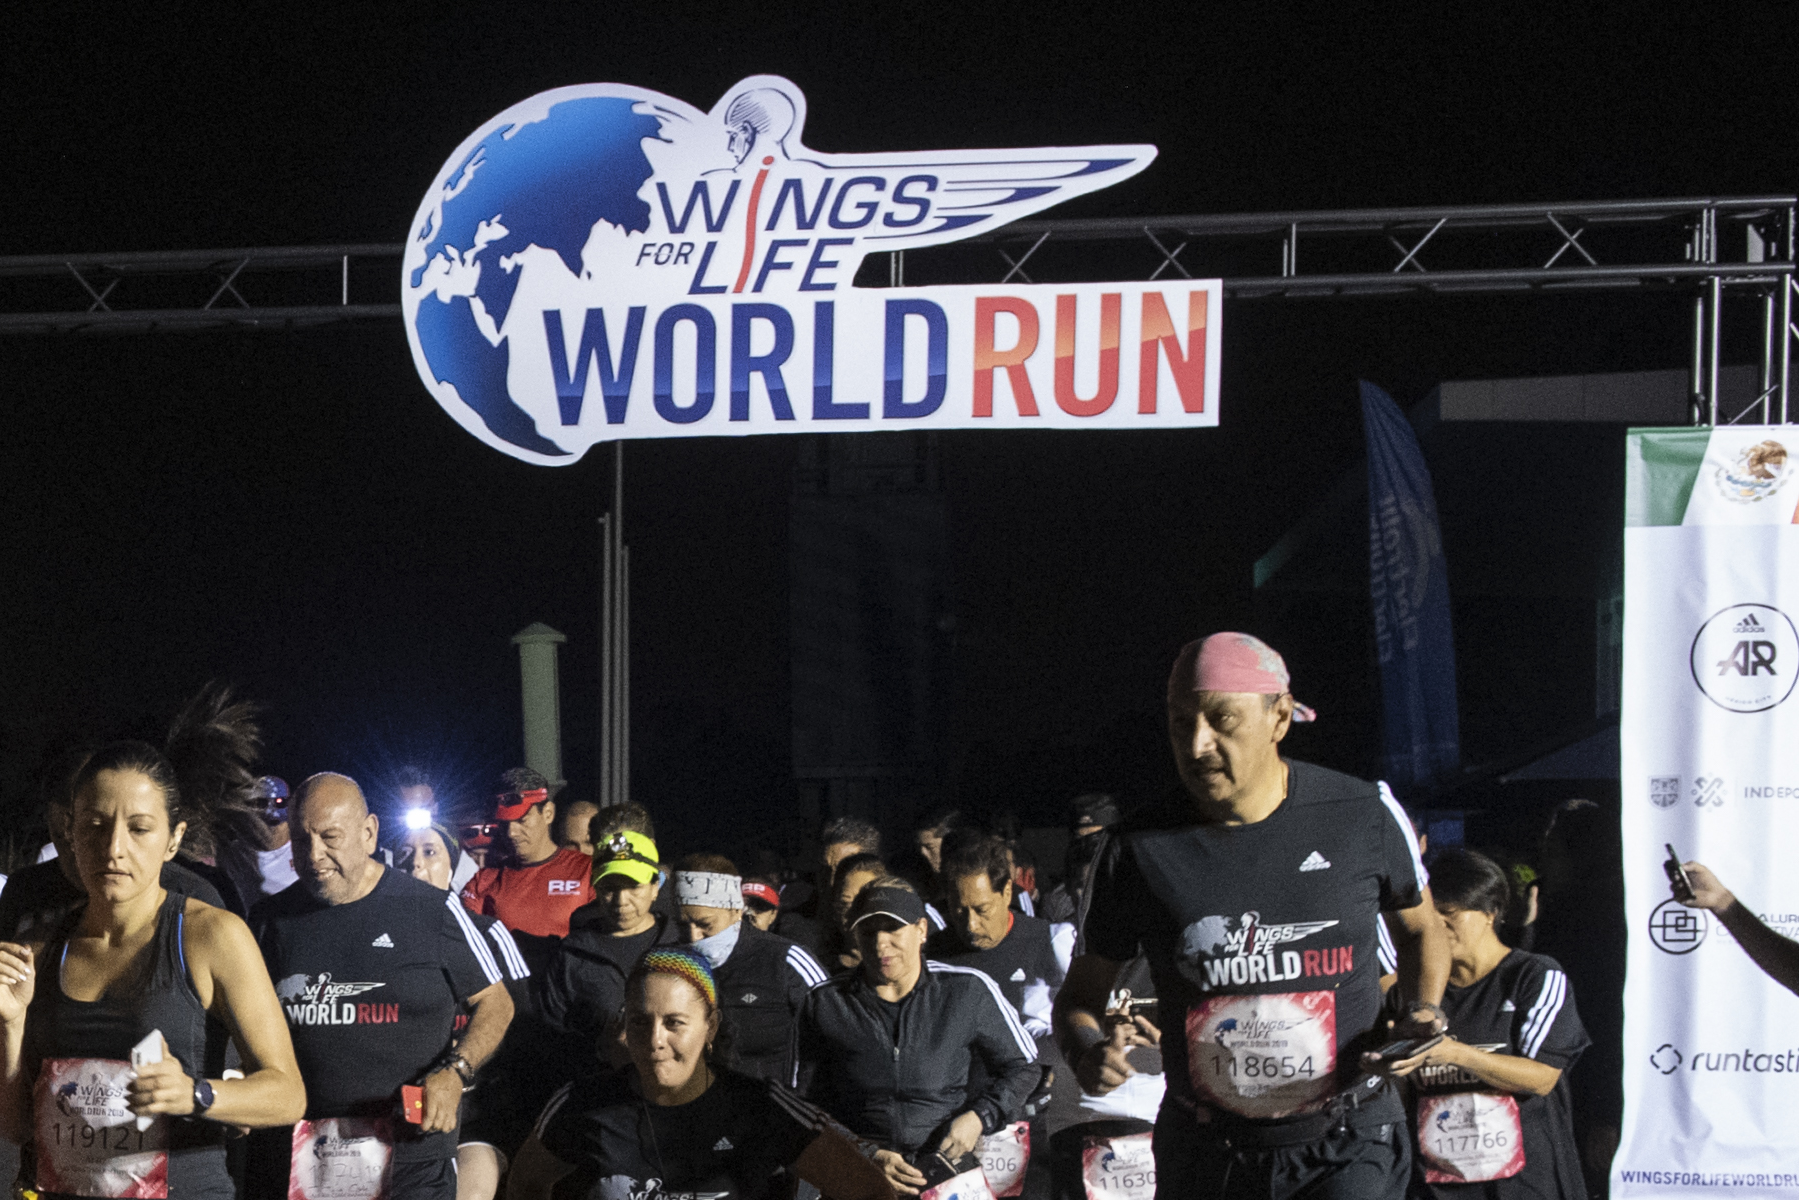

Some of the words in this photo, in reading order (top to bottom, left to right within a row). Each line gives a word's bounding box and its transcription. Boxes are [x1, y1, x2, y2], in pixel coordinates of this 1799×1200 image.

[656, 172, 938, 233] WINGS
[635, 241, 695, 267] FOR
[687, 238, 857, 295] LIFE
[542, 299, 949, 427] WORLD
[971, 289, 1209, 419] RUN
[1733, 626, 1765, 634] adidas
[1716, 640, 1778, 676] AR
[1227, 927, 1295, 945] WINGS
[1203, 950, 1302, 987] WORLD
[1304, 945, 1353, 977] RUN
[286, 1003, 356, 1025] WORLD
[357, 1003, 399, 1025] RUN
[1210, 1054, 1316, 1079] 118654
[52, 1122, 144, 1150] 119121
[1435, 1130, 1507, 1153] 117766
